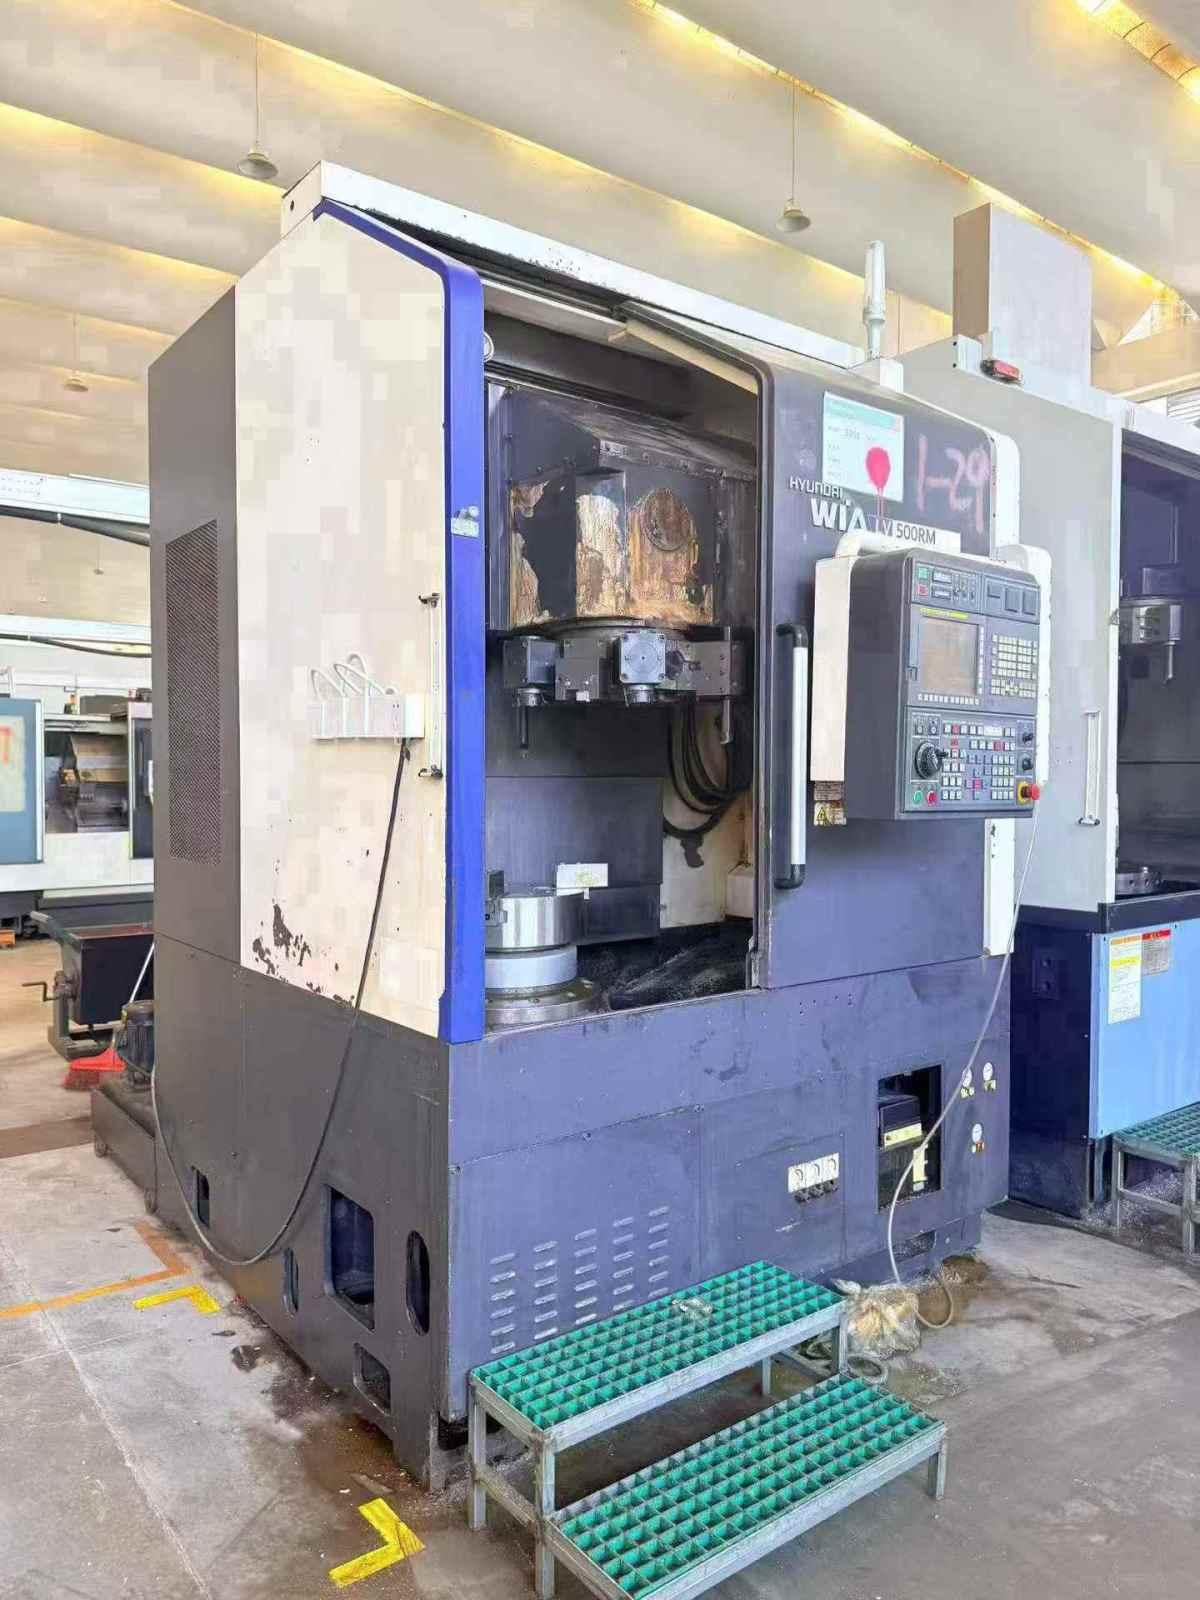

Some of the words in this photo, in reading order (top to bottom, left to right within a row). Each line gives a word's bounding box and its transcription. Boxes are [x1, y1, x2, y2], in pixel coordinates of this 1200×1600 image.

[789, 475, 843, 500] HYUNDAI
[810, 498, 868, 532] WIA
[895, 521, 937, 546] 500RM
